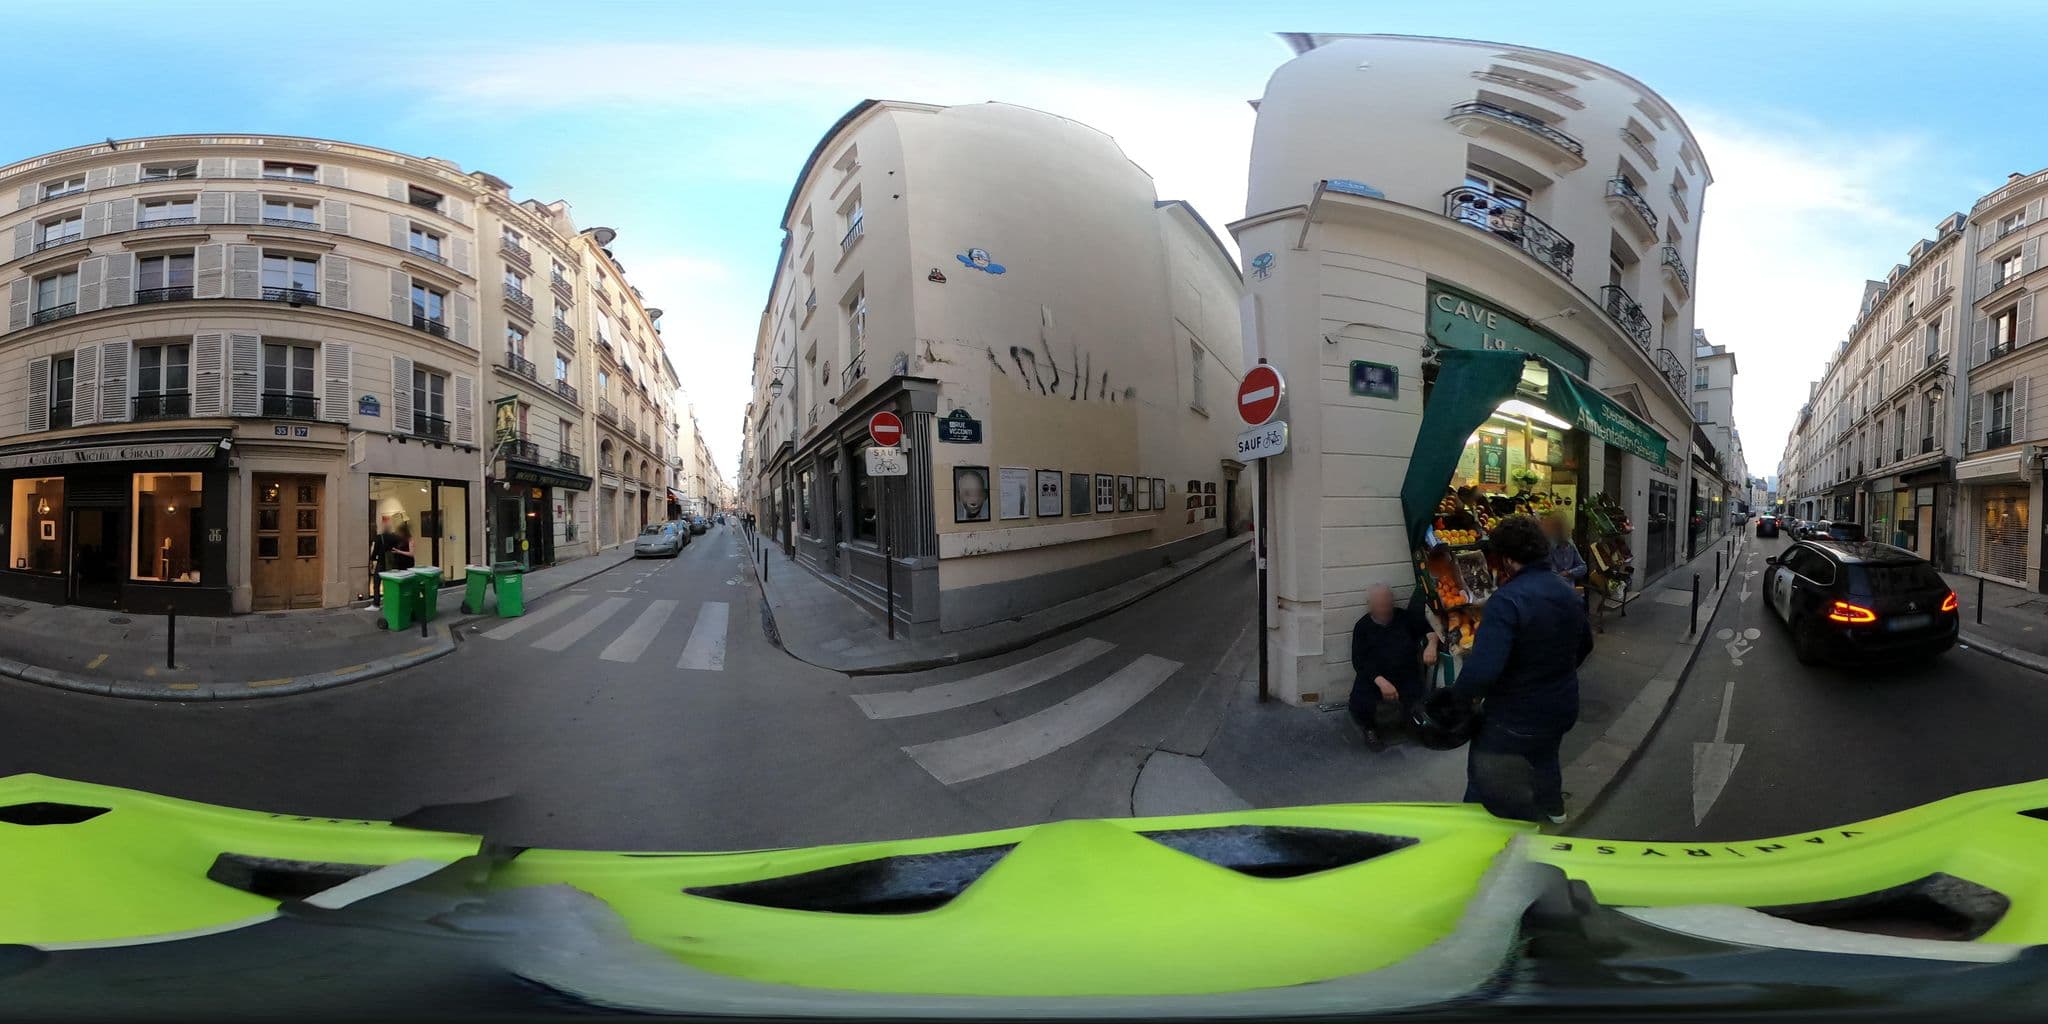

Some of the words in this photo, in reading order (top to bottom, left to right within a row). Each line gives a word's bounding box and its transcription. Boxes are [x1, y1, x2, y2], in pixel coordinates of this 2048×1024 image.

[1435, 294, 1497, 330] CAVE
[276, 426, 287, 435] 35
[296, 427, 306, 436] 37
[1238, 436, 1262, 453] SAUF
[873, 448, 900, 457] SAUF
